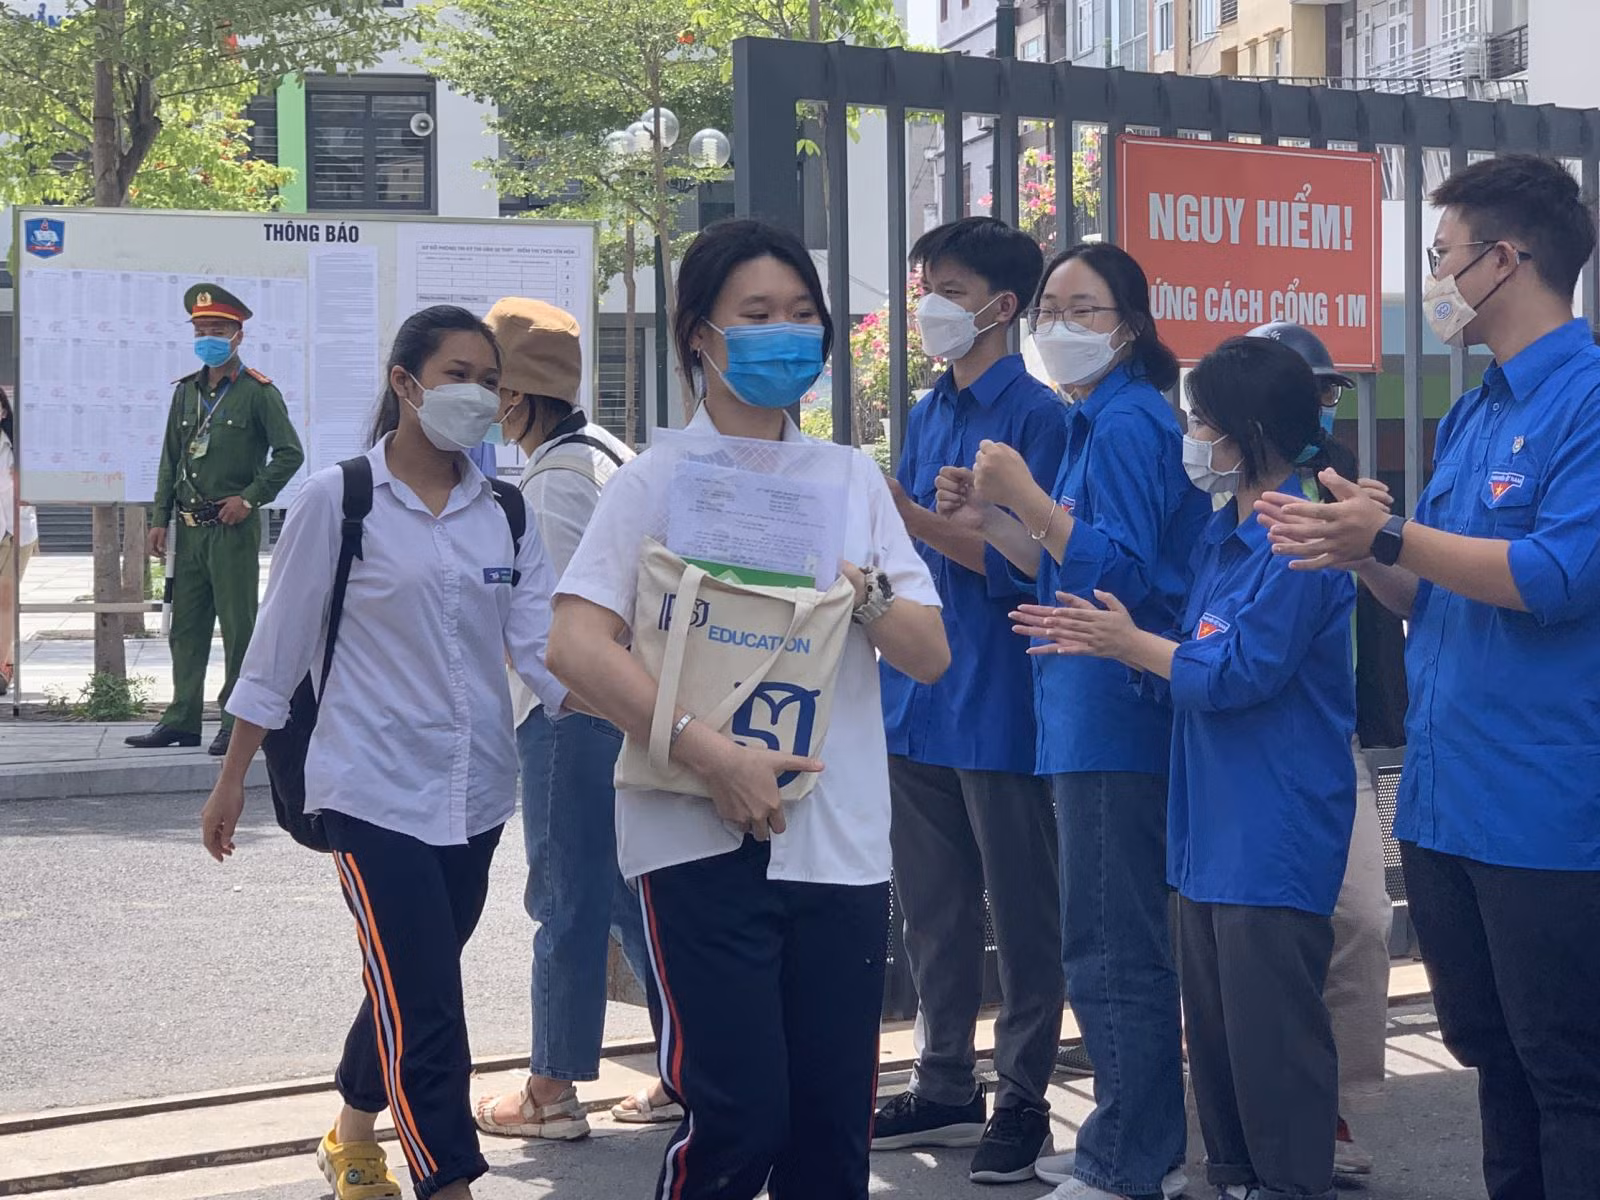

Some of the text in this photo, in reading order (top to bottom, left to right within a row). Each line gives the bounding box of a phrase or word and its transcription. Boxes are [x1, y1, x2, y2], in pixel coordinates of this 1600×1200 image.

[263, 220, 359, 243] THÔNG BÁO
[1149, 183, 1353, 251] NGUY HIỂM!
[1150, 277, 1197, 321] ỨNG
[1204, 281, 1263, 323] CÁCH
[1270, 277, 1328, 326] CỔNG
[708, 625, 811, 654] EDUCATION
